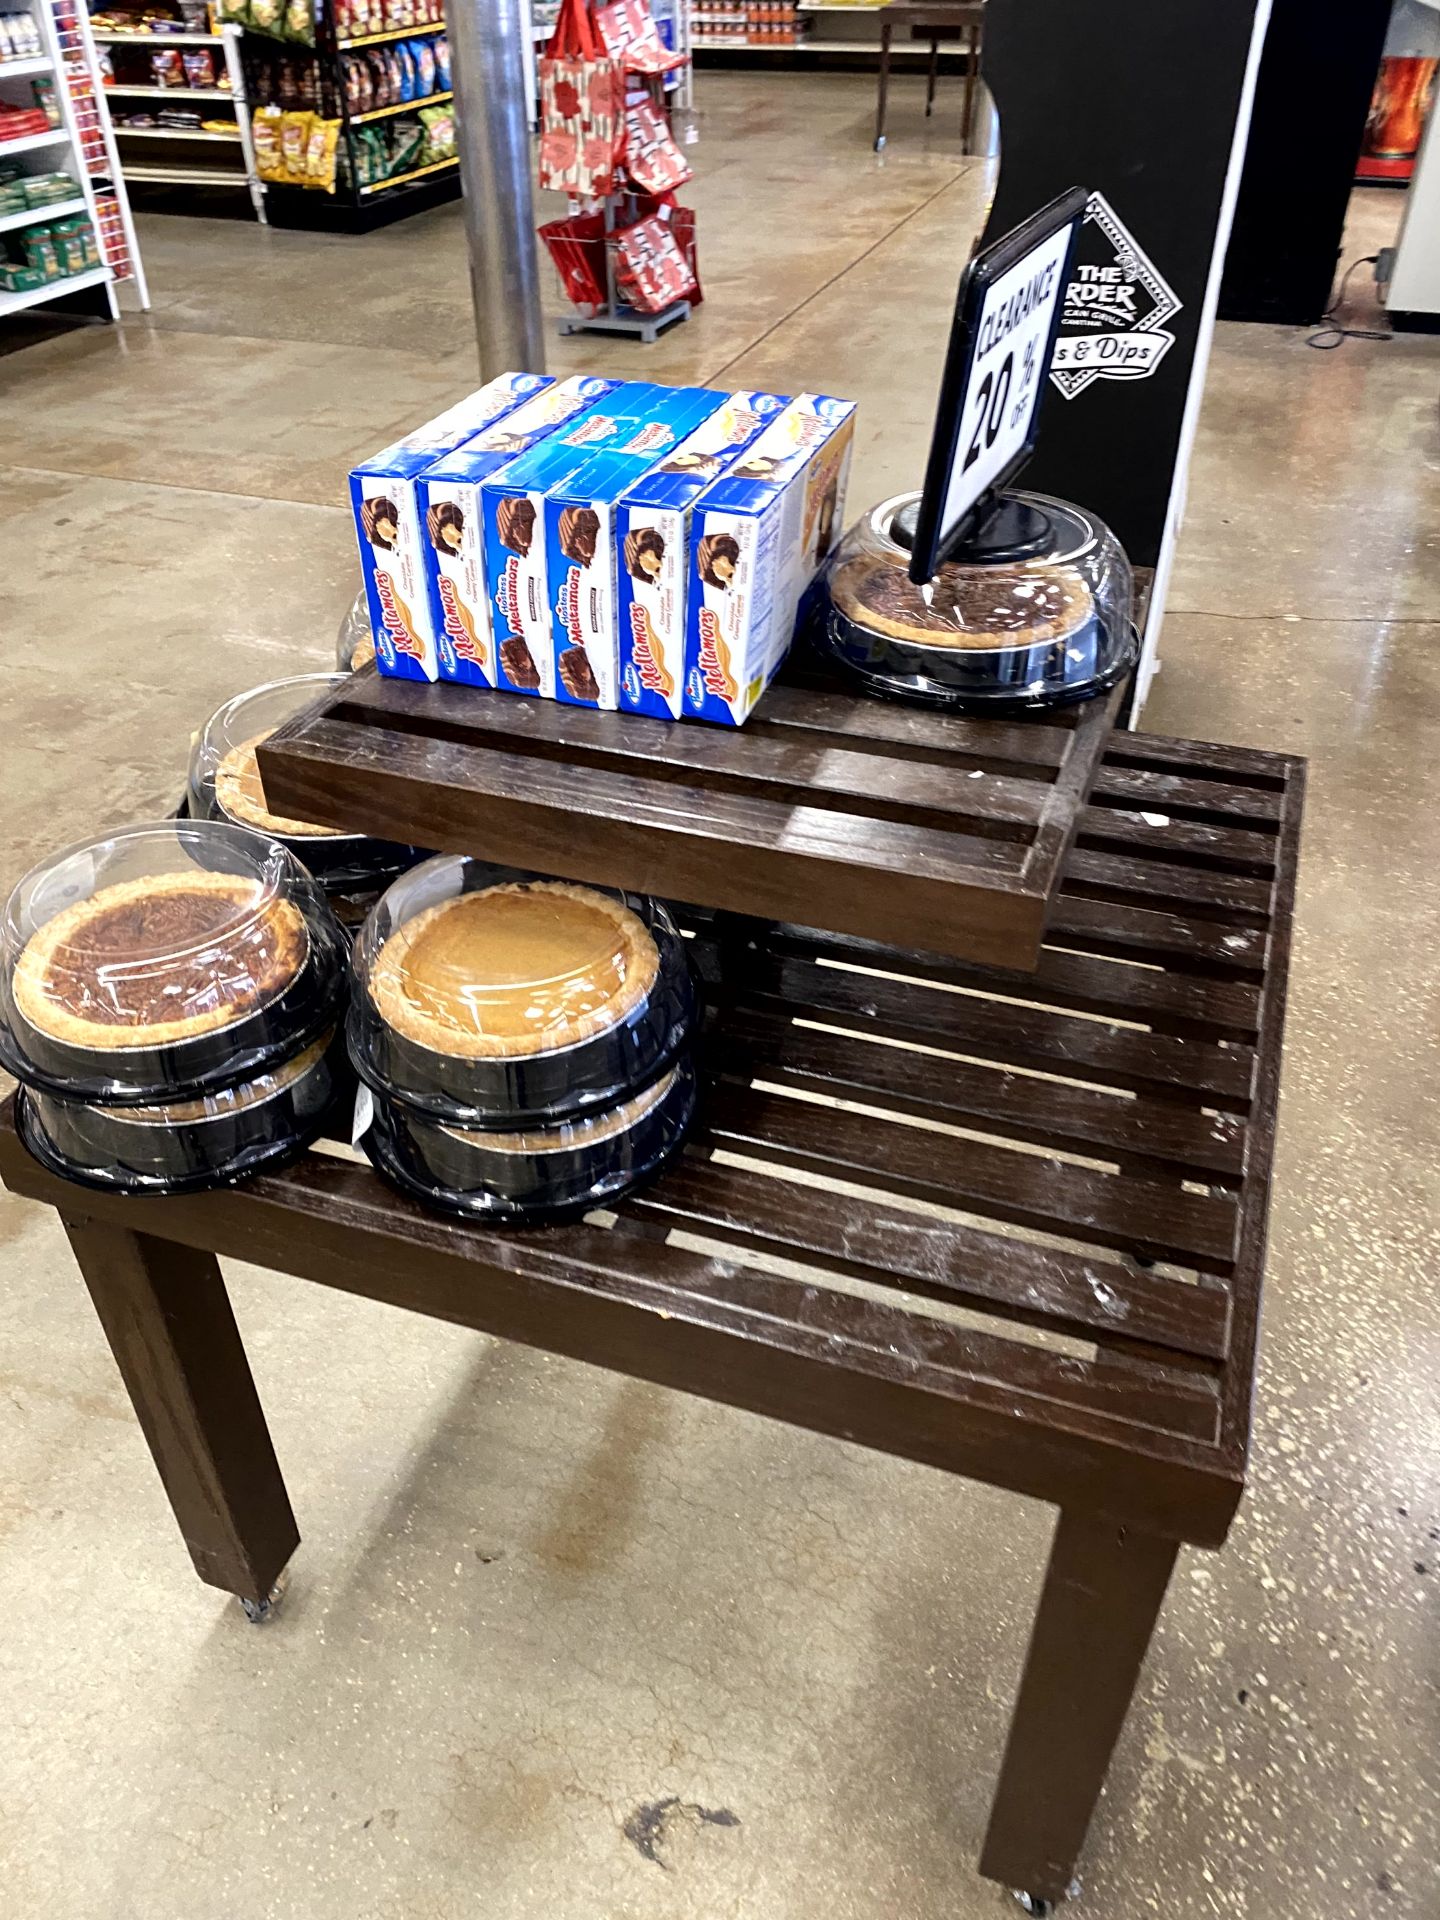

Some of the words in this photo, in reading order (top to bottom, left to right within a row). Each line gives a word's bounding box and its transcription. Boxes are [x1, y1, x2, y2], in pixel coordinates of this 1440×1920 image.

[977, 258, 1058, 361] CLEARANCE
[1065, 282, 1137, 311] RDER
[1077, 265, 1123, 283] THE
[1074, 341, 1091, 361] &
[1095, 337, 1152, 364] Dips
[961, 351, 1014, 477] 20
[374, 569, 423, 661] Meltamors
[438, 574, 485, 667] Meltamors
[507, 558, 525, 635] Meltamors
[561, 587, 569, 624] Hostess
[568, 568, 585, 646] Meltamors
[631, 604, 670, 698] Meltamors
[699, 609, 733, 703] Meltamors
